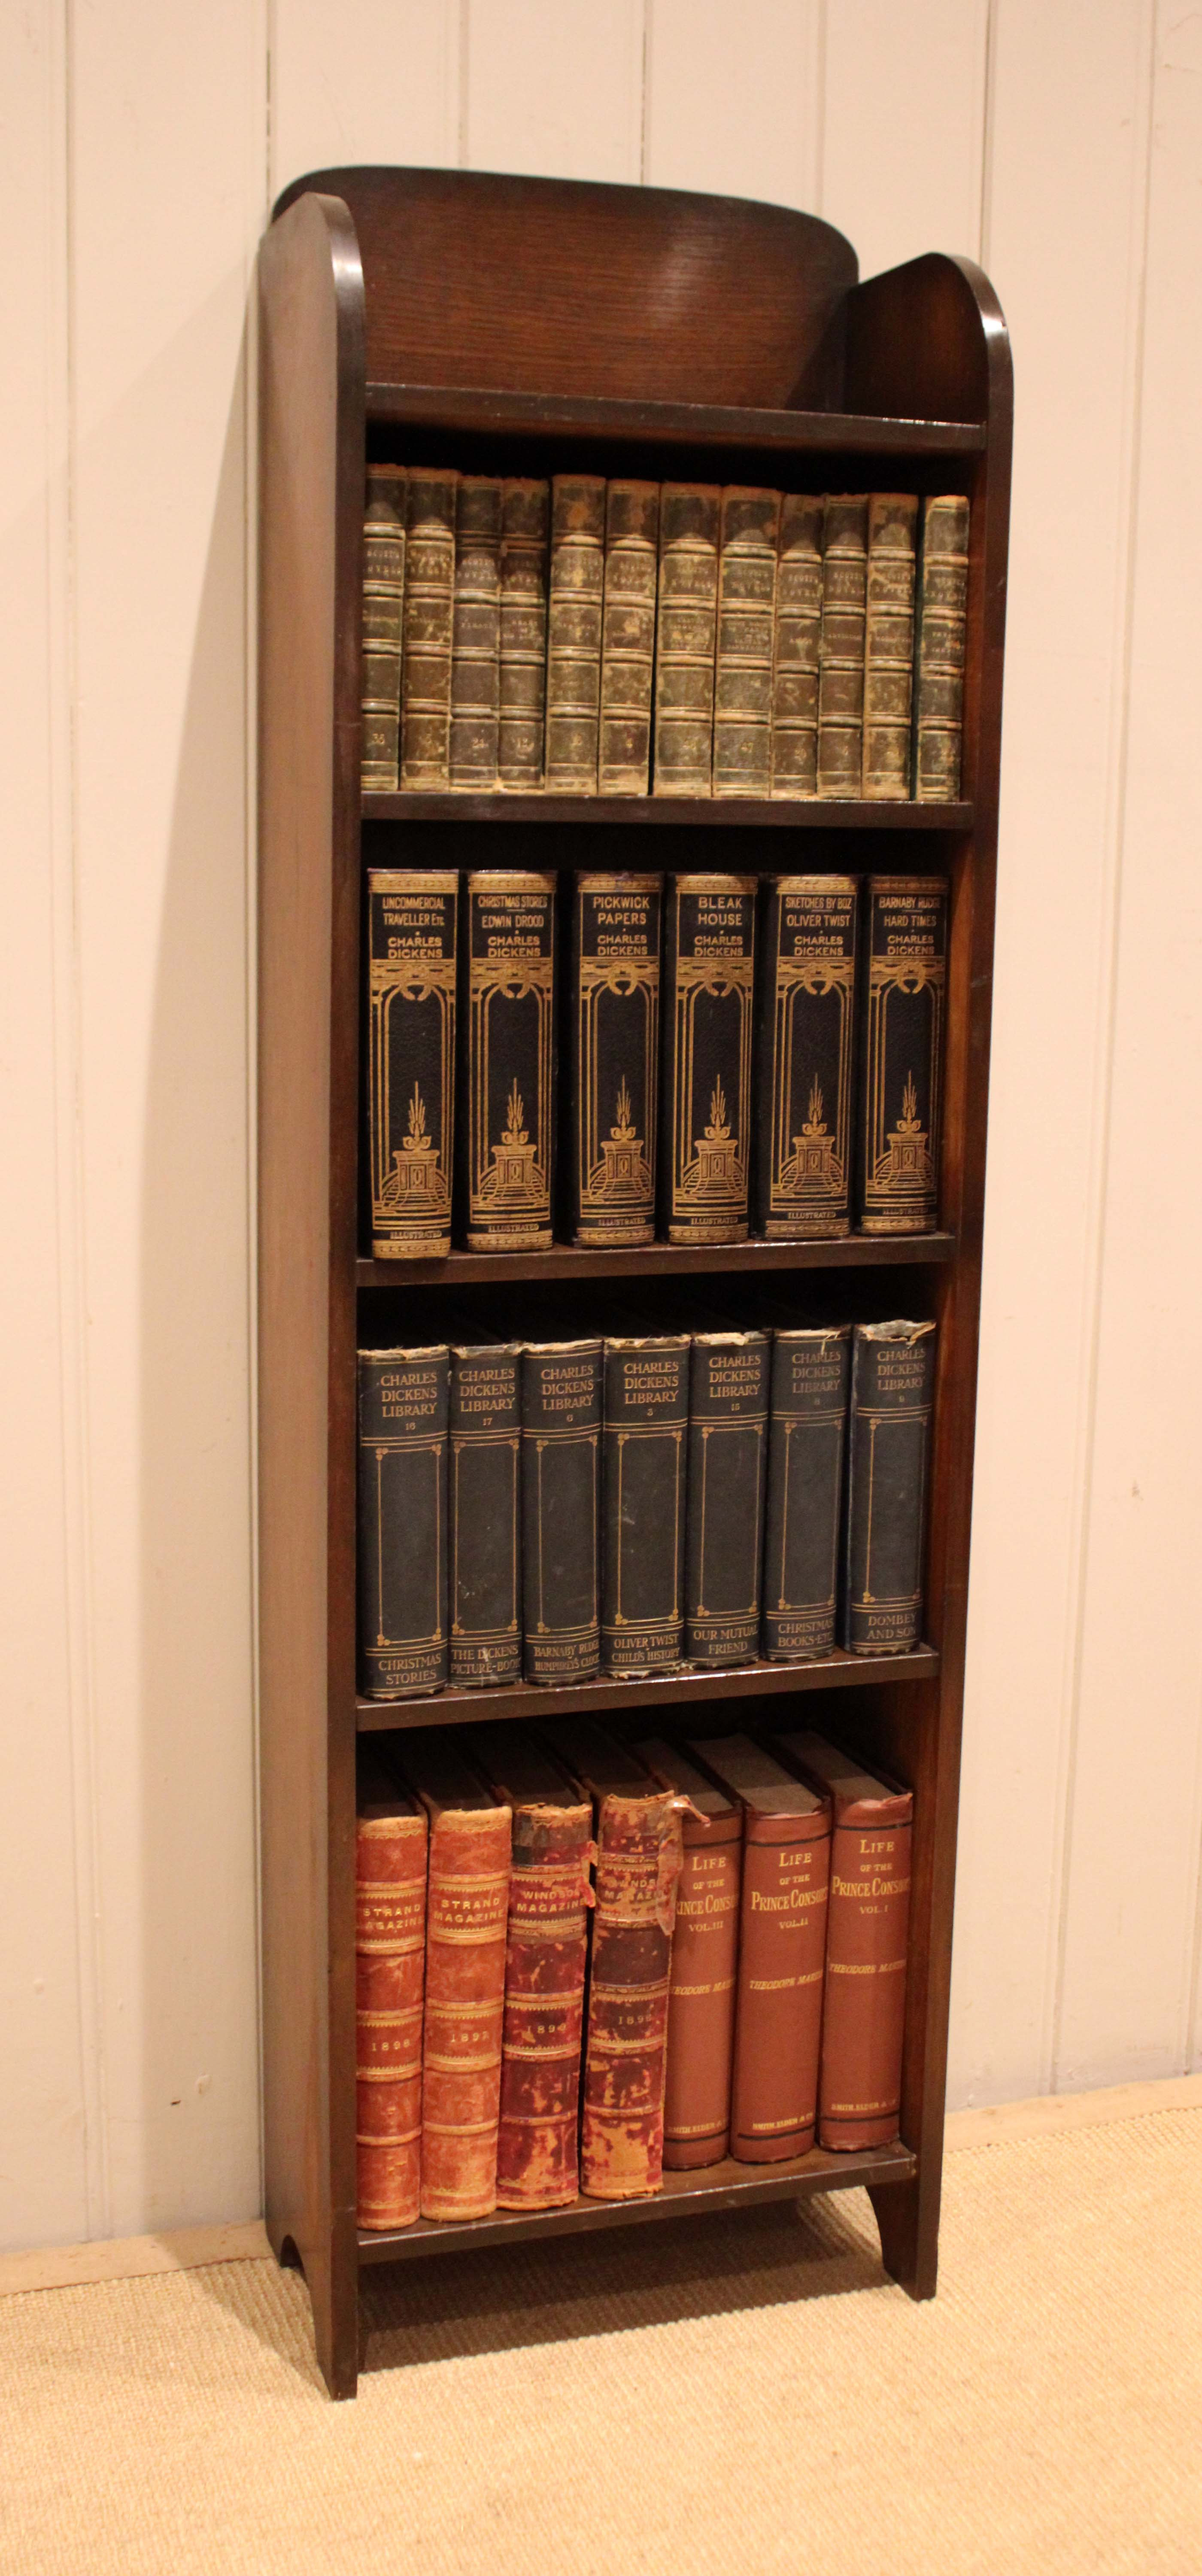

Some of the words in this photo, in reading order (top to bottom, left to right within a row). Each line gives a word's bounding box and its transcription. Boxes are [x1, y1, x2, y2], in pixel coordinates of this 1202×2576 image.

[382, 897, 446, 910] UNCOMMERCIAL
[478, 896, 520, 908] CHRISTMAS
[521, 896, 548, 908] STORIES
[593, 896, 650, 909] PICKWICK
[698, 897, 742, 909] BLEAK
[786, 897, 824, 909] SKETCHES
[826, 897, 836, 909] BY
[837, 897, 852, 909] BOZ
[879, 897, 916, 908] BARNABY
[384, 913, 430, 926] TRAVELLER
[482, 916, 511, 928] EDWIN
[516, 915, 544, 927] DROOD
[598, 913, 647, 925] PAPERS
[698, 913, 742, 926] HOUSE
[787, 915, 821, 927] OLIVER
[824, 914, 850, 926] TWIST
[884, 915, 908, 926] HARD
[911, 915, 936, 926] TIMES
[388, 937, 442, 947] CHARLES
[488, 936, 540, 946] CHARLES
[598, 935, 647, 944] CHARLES
[695, 936, 743, 945] CHARLES
[795, 936, 843, 945] CHARLES
[887, 936, 933, 944] CHARLES
[388, 949, 443, 959] DICKENS
[488, 948, 540, 958] DICKENS
[598, 946, 647, 956] DICKENS
[695, 947, 743, 957] DICKENS
[794, 947, 844, 956] DICKENS
[887, 946, 934, 955] DICKENS
[788, 1211, 836, 1220] ILLUSTRATED
[883, 1207, 929, 1215] ILLUSTRATED
[598, 1218, 646, 1226] ILLUSTRATED
[691, 1216, 738, 1225] ILLUSTRATED
[390, 1230, 442, 1239] ILLUSTRATED
[489, 1223, 539, 1233] ILLUSTRATED
[709, 1355, 761, 1368] CHARLES
[792, 1351, 841, 1364] CHARLES
[877, 1349, 926, 1361] CHARLES
[541, 1365, 594, 1380] CHARLES
[624, 1361, 679, 1374] CHARLES
[792, 1365, 841, 1379] DICKENS
[878, 1363, 925, 1376] DICKENS
[381, 1371, 437, 1386] CHARLES
[459, 1368, 515, 1382] CHARLES
[710, 1369, 761, 1382] DICKENS
[542, 1380, 594, 1395] DICKENS
[625, 1376, 679, 1389] DICKENS
[793, 1380, 841, 1393] LIBRARY
[878, 1376, 925, 1391] LIBRARY
[381, 1387, 437, 1402] DICKENS
[460, 1383, 515, 1397] DICKENS
[710, 1384, 761, 1397] LIBRARY
[543, 1394, 594, 1410] LIBRARY
[625, 1390, 679, 1404] LIBRARY
[382, 1402, 438, 1417] LIBRARY
[460, 1397, 515, 1412] LIBRARY
[731, 1403, 740, 1411] 15
[647, 1408, 653, 1416] 3
[405, 1422, 416, 1431] 16
[483, 1418, 492, 1426] 17
[778, 1617, 834, 1634] CHRISTMAS
[868, 1613, 916, 1626] DOMBEY
[693, 1630, 717, 1641] OUR
[867, 1629, 894, 1640] AND
[614, 1637, 650, 1651] OLIVER
[651, 1634, 679, 1646] TWIST
[709, 1641, 748, 1654] FRIEND
[452, 1649, 474, 1660] THE
[477, 1645, 518, 1660] DCKENS
[534, 1645, 576, 1660] BARNABY
[647, 1647, 680, 1661] HISTORY
[379, 1653, 441, 1671] CHRISTMAS
[386, 1669, 437, 1685] STORIES
[874, 1863, 892, 1871] THE
[693, 1881, 704, 1890] OF
[707, 1879, 725, 1888] THE
[779, 1877, 790, 1886] OF
[793, 1874, 810, 1883] THE
[363, 1904, 421, 1917] STRAND
[441, 1898, 500, 1910] STRAND
[365, 1916, 424, 1930] AGAZINE
[434, 1910, 504, 1923] MAGAZINE
